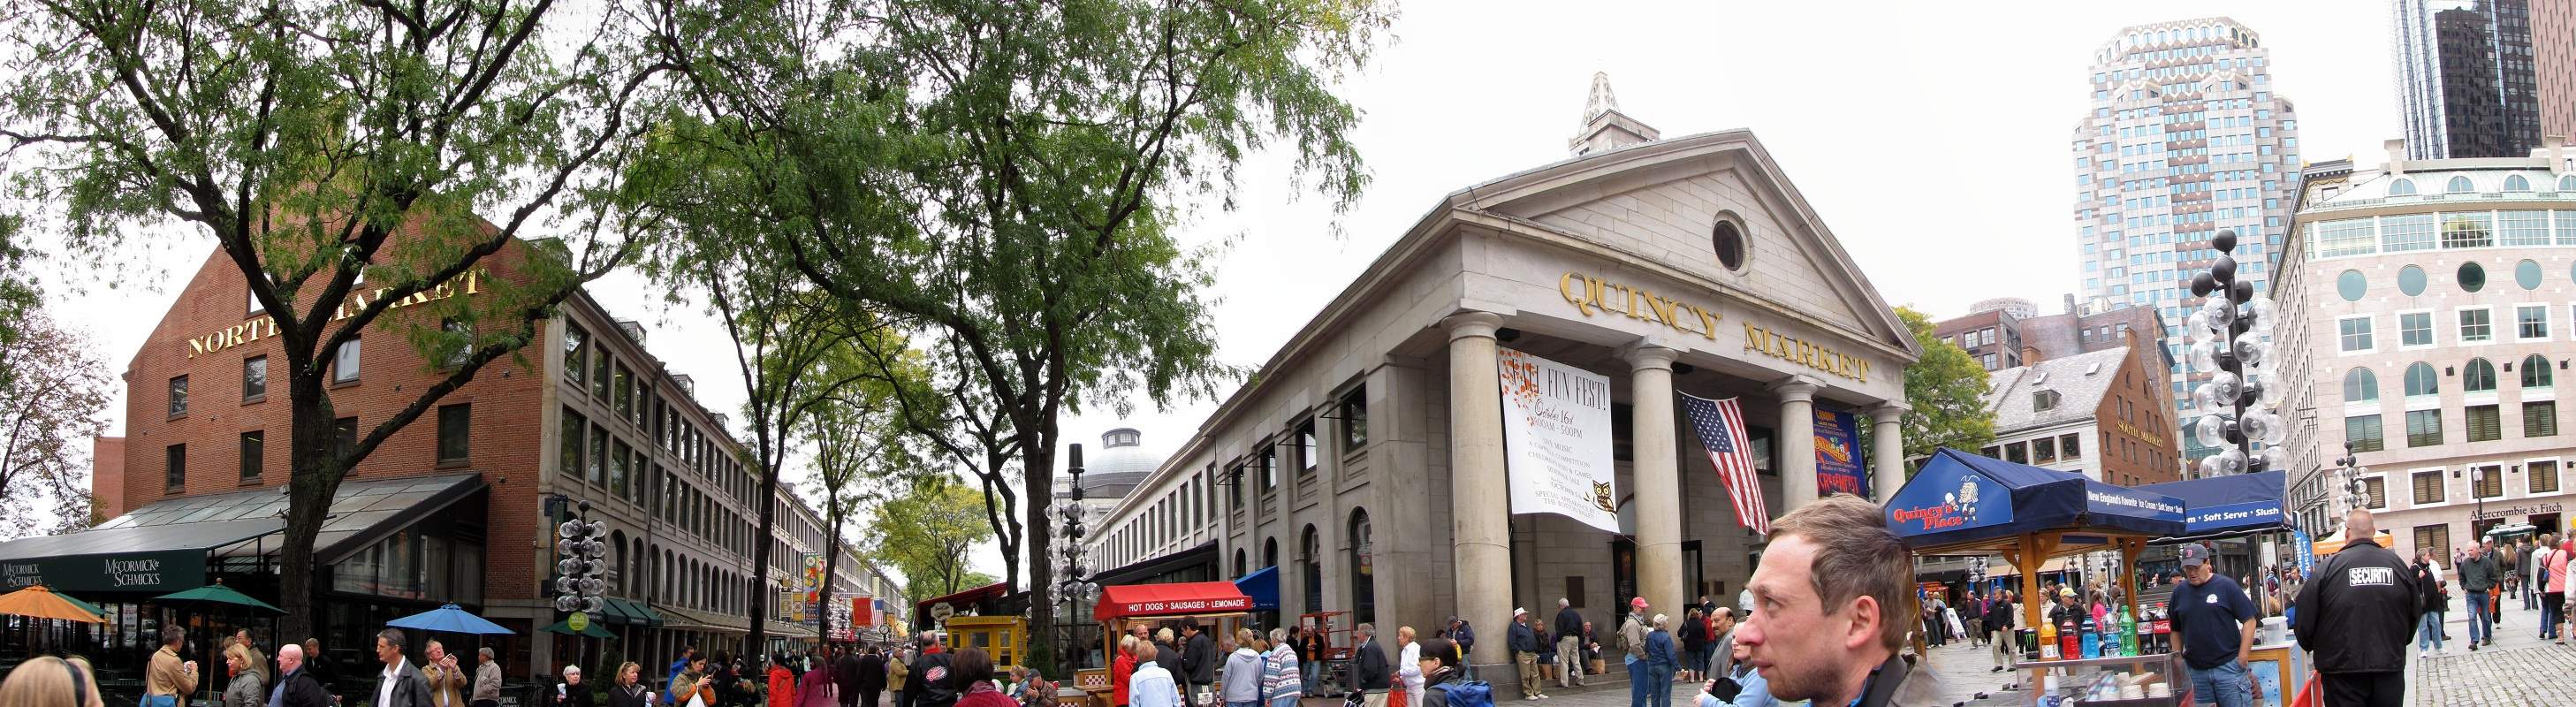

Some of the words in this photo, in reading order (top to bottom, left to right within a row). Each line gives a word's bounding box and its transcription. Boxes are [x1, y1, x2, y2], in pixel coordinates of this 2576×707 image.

[1560, 271, 1721, 340] QUINCY
[1744, 321, 1874, 383] MARKET
[1547, 368, 1570, 402] FUN
[1577, 376, 1607, 412] FEST!
[2140, 430, 2163, 449] MARKET
[2087, 490, 2099, 502] New
[2121, 496, 2138, 508] Favorite
[1894, 501, 1954, 524] Quincy's
[2203, 513, 2222, 522] Soft
[2223, 510, 2248, 520] Serve
[2255, 506, 2280, 516] Slush
[2539, 502, 2563, 513] Fitch
[1923, 515, 1964, 531] Place
[114, 572, 161, 587] SCHMICK'S
[2351, 569, 2391, 584] SECURITY
[1128, 604, 1142, 612] HOT
[1145, 602, 1164, 611] DOGS
[1170, 600, 1205, 610] SAUSAGES
[1211, 598, 1245, 609] LEMONADE
